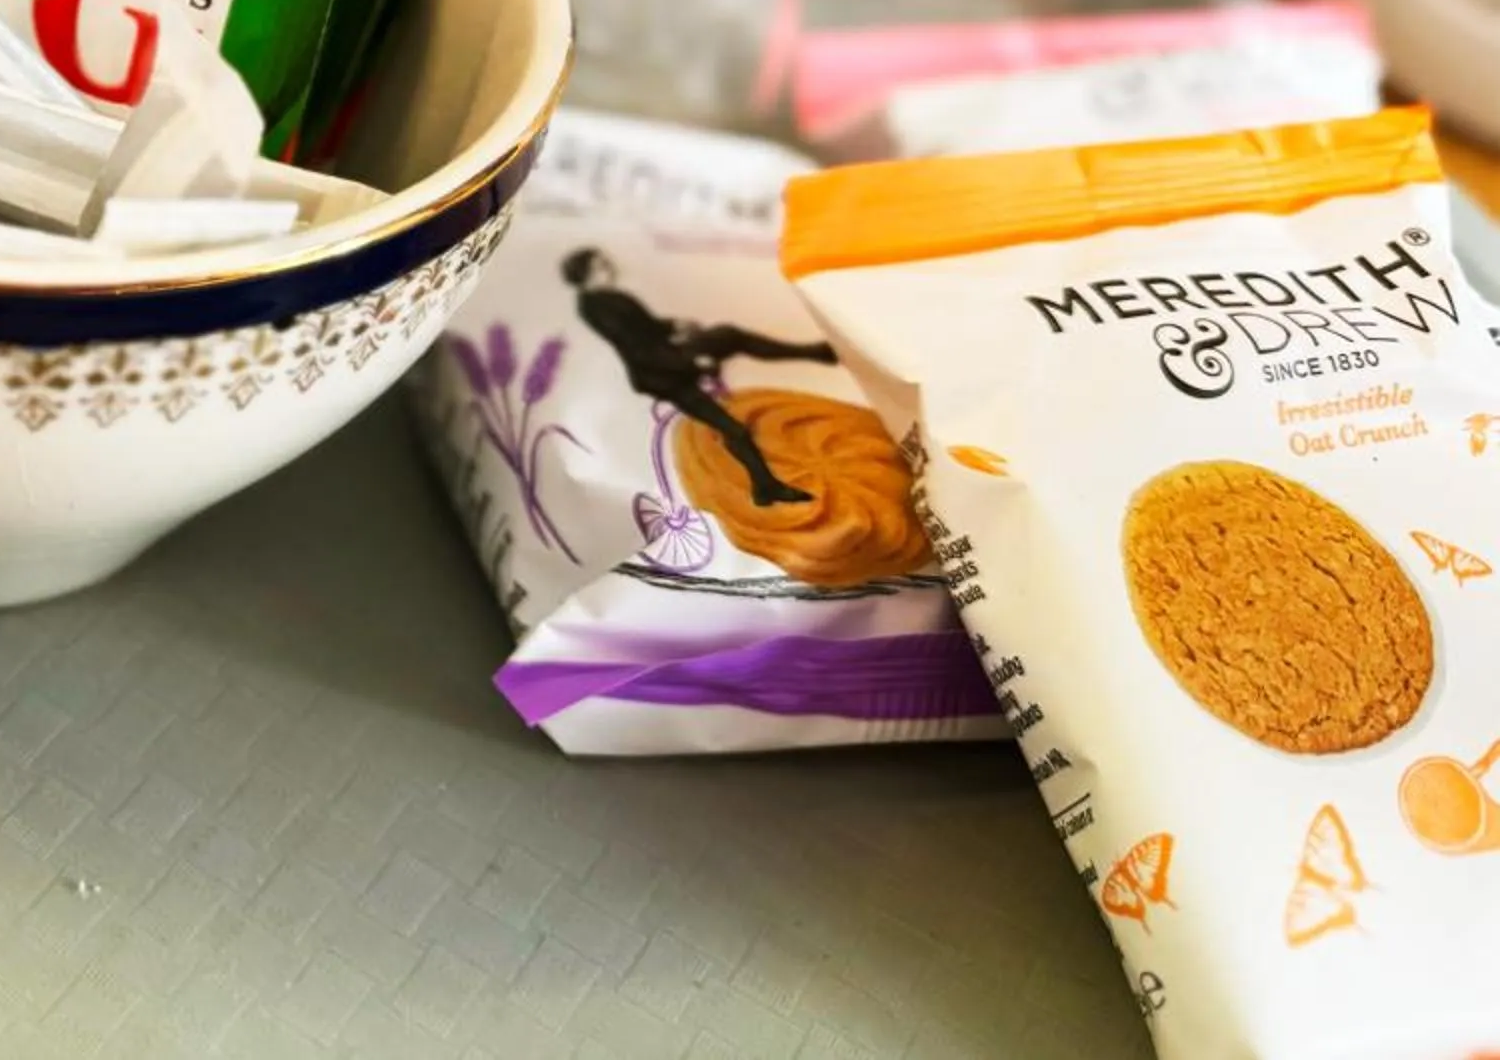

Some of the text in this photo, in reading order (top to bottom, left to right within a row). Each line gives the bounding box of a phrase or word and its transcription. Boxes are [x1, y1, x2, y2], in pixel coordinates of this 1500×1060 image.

[1152, 278, 1461, 399] & DREW
[1261, 348, 1381, 384] SINCE 1830
[1275, 382, 1415, 427] Irresistible
[1288, 411, 1430, 457] Oat Crunch
